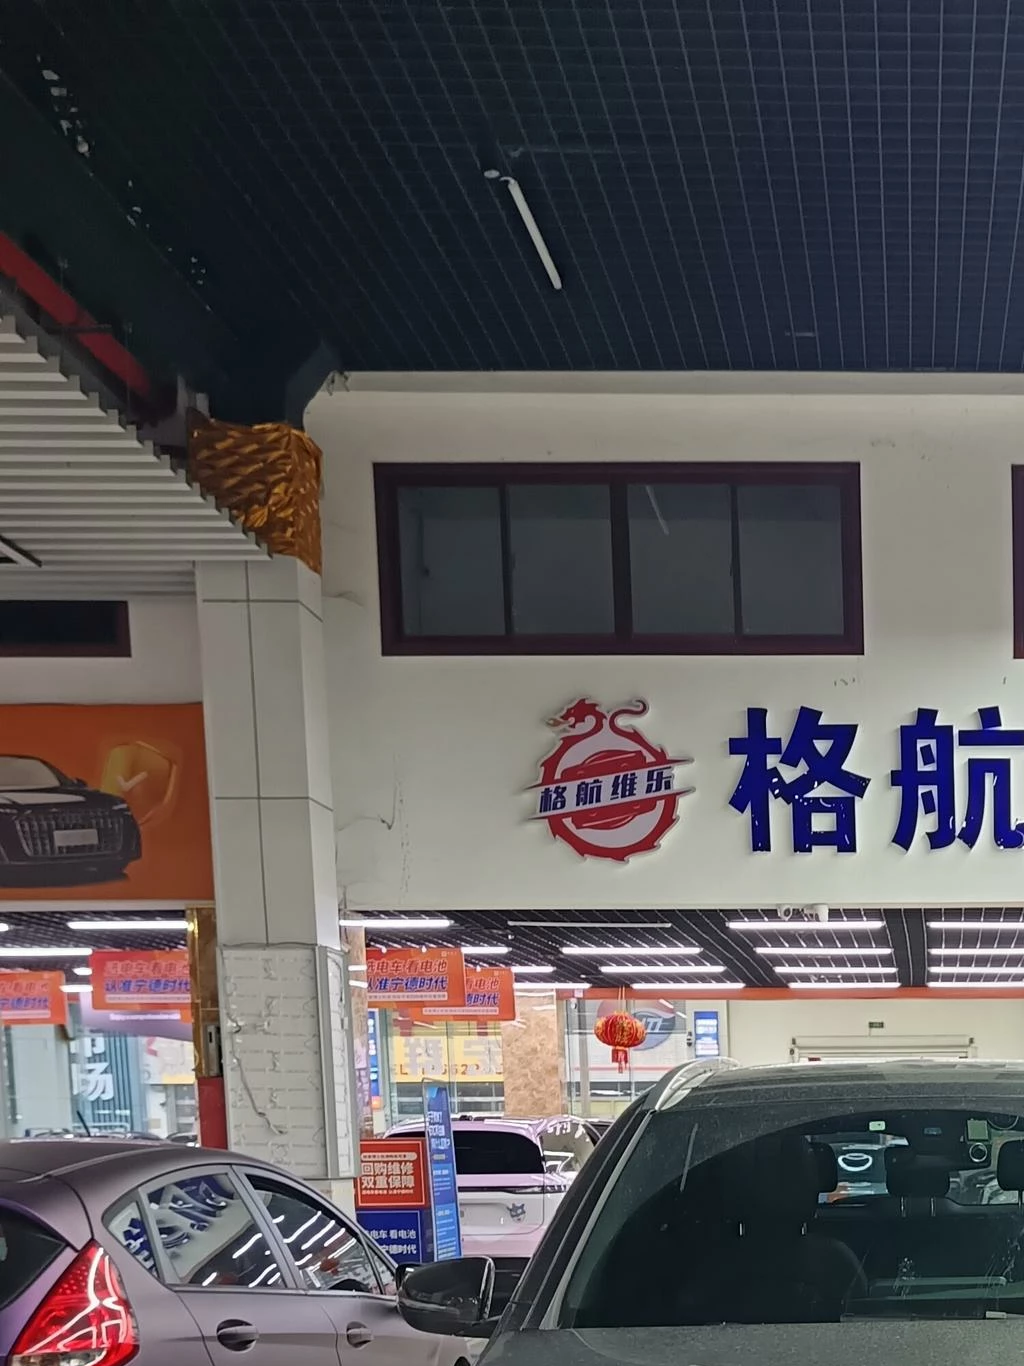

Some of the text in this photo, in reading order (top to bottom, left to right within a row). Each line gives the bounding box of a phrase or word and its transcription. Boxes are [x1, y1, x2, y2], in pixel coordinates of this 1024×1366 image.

[539, 766, 674, 813] 格航维乐
[361, 1162, 415, 1176] 回购维修
[361, 1175, 416, 1189] 双重保障
